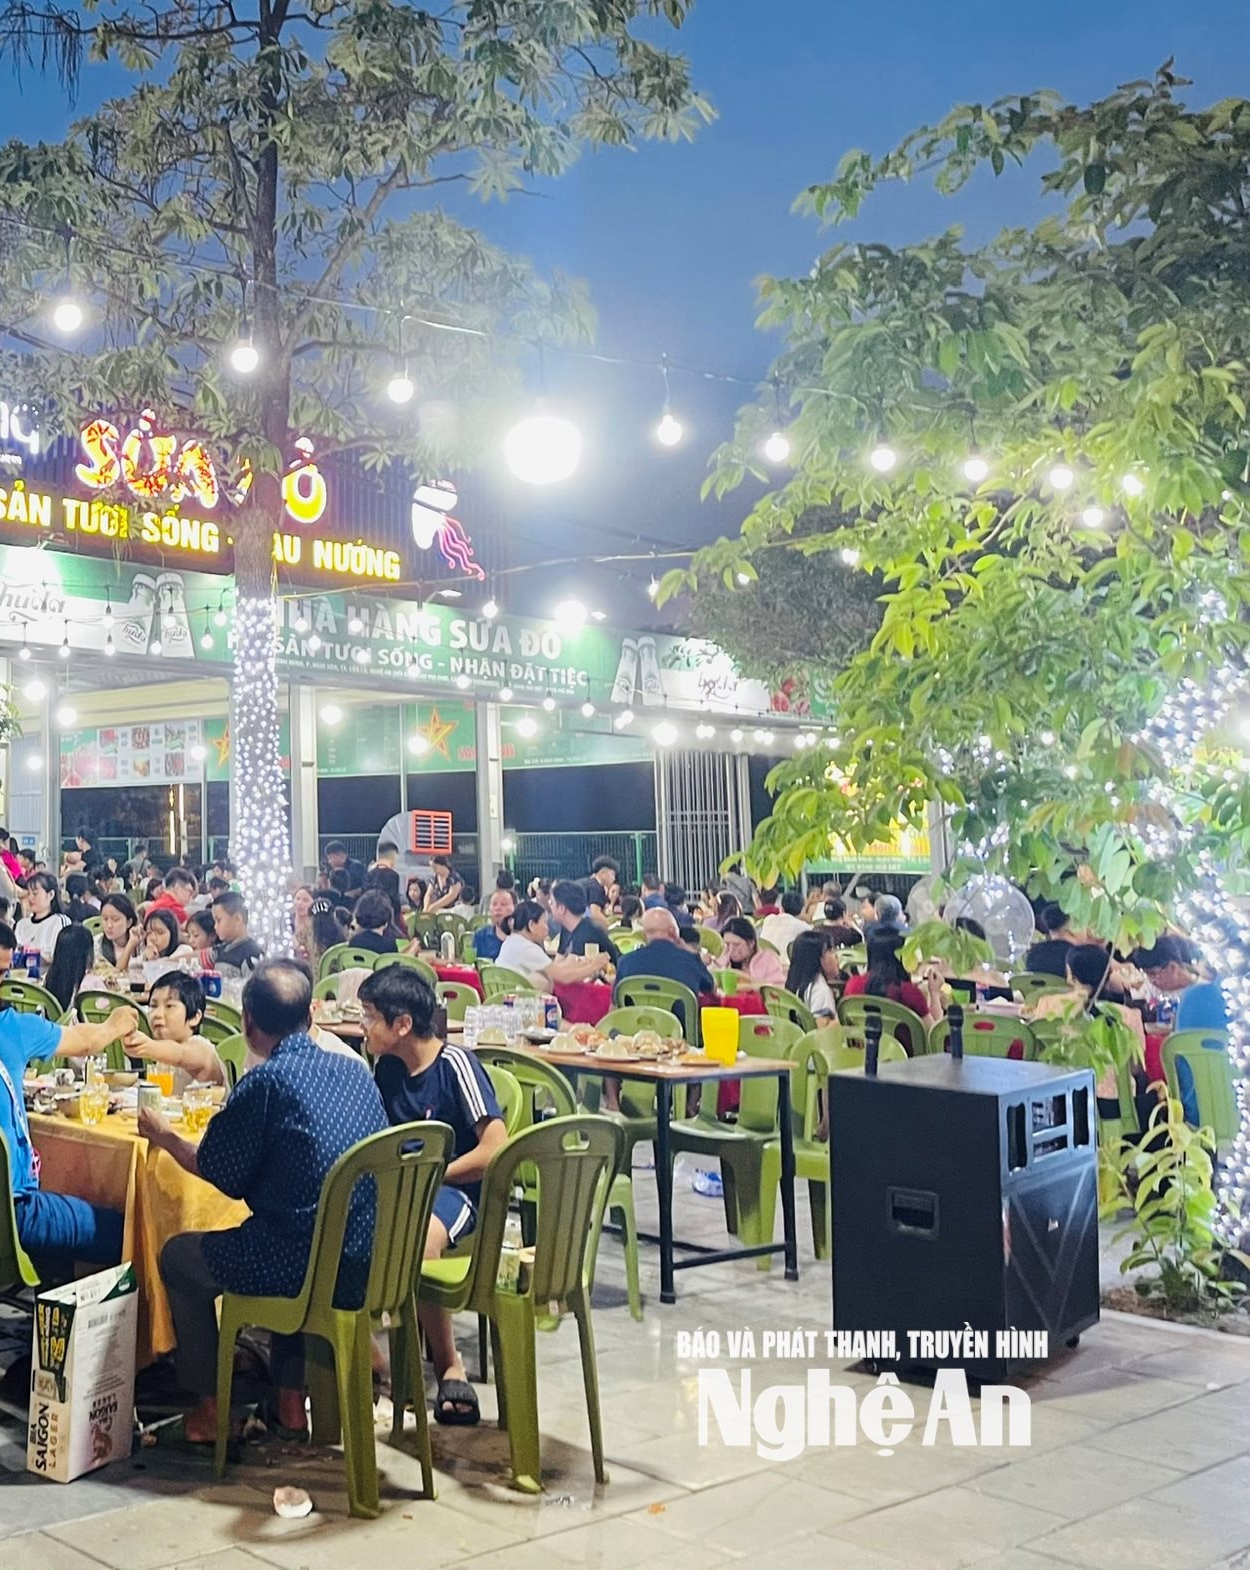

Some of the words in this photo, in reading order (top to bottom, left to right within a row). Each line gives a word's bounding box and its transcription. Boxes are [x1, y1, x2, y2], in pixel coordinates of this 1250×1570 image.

[141, 504, 220, 552] SỐNG
[313, 537, 400, 580] NƯỚNG
[347, 602, 442, 647] HÀNG
[449, 616, 513, 655] SỨA
[378, 647, 433, 670] SỐNG
[450, 656, 506, 680] NHẬN
[510, 662, 546, 685] ĐẶT
[549, 667, 588, 690] TIỆC
[36, 1403, 49, 1471] SAIGON
[48, 1412, 59, 1469] LAGER
